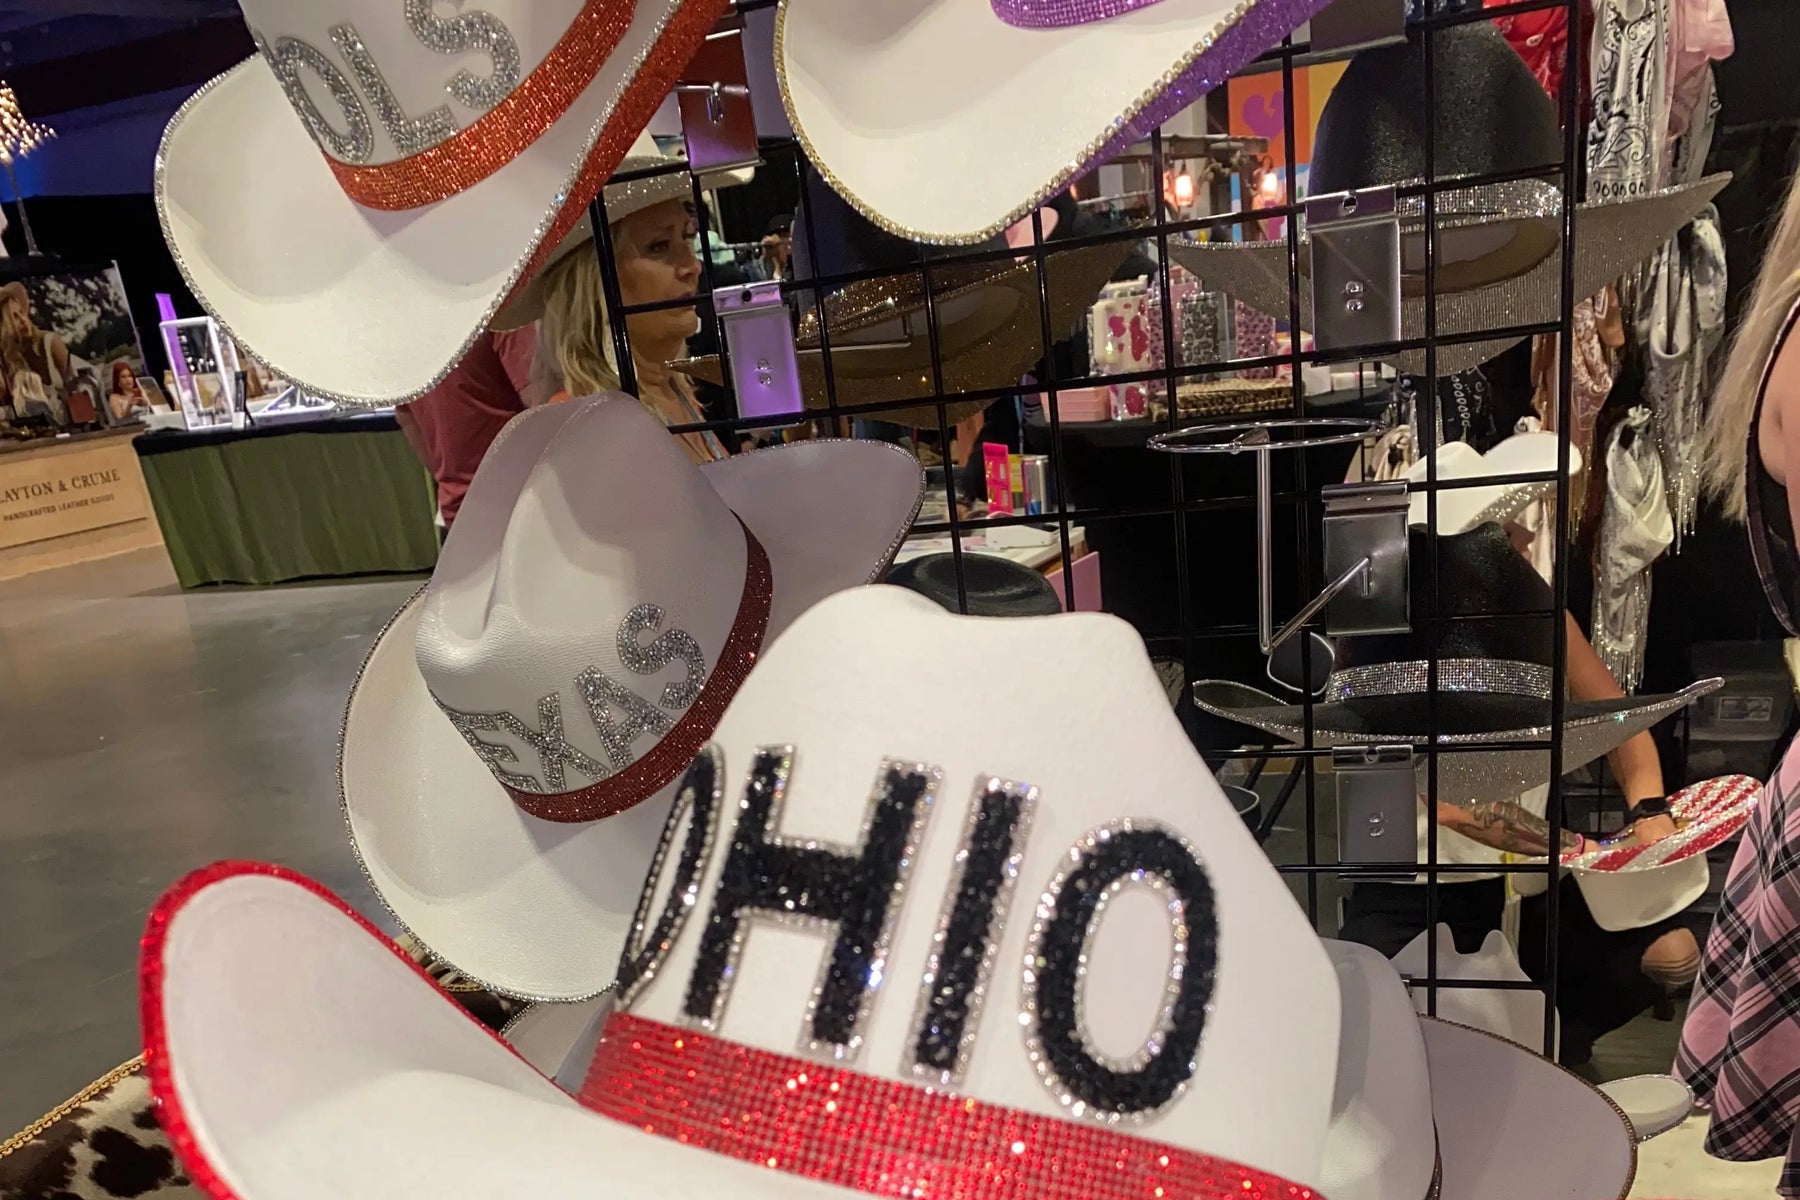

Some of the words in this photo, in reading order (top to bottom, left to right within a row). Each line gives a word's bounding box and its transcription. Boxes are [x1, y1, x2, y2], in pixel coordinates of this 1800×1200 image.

[252, 0, 520, 164] OLS
[0, 481, 54, 504] AYTON
[58, 480, 69, 492] &
[71, 468, 121, 489] CRUME
[3, 505, 57, 521] HANDCRAFTED
[58, 498, 89, 511] LEATHER
[430, 602, 706, 793] EXAS
[615, 742, 1218, 1127] OHIO
